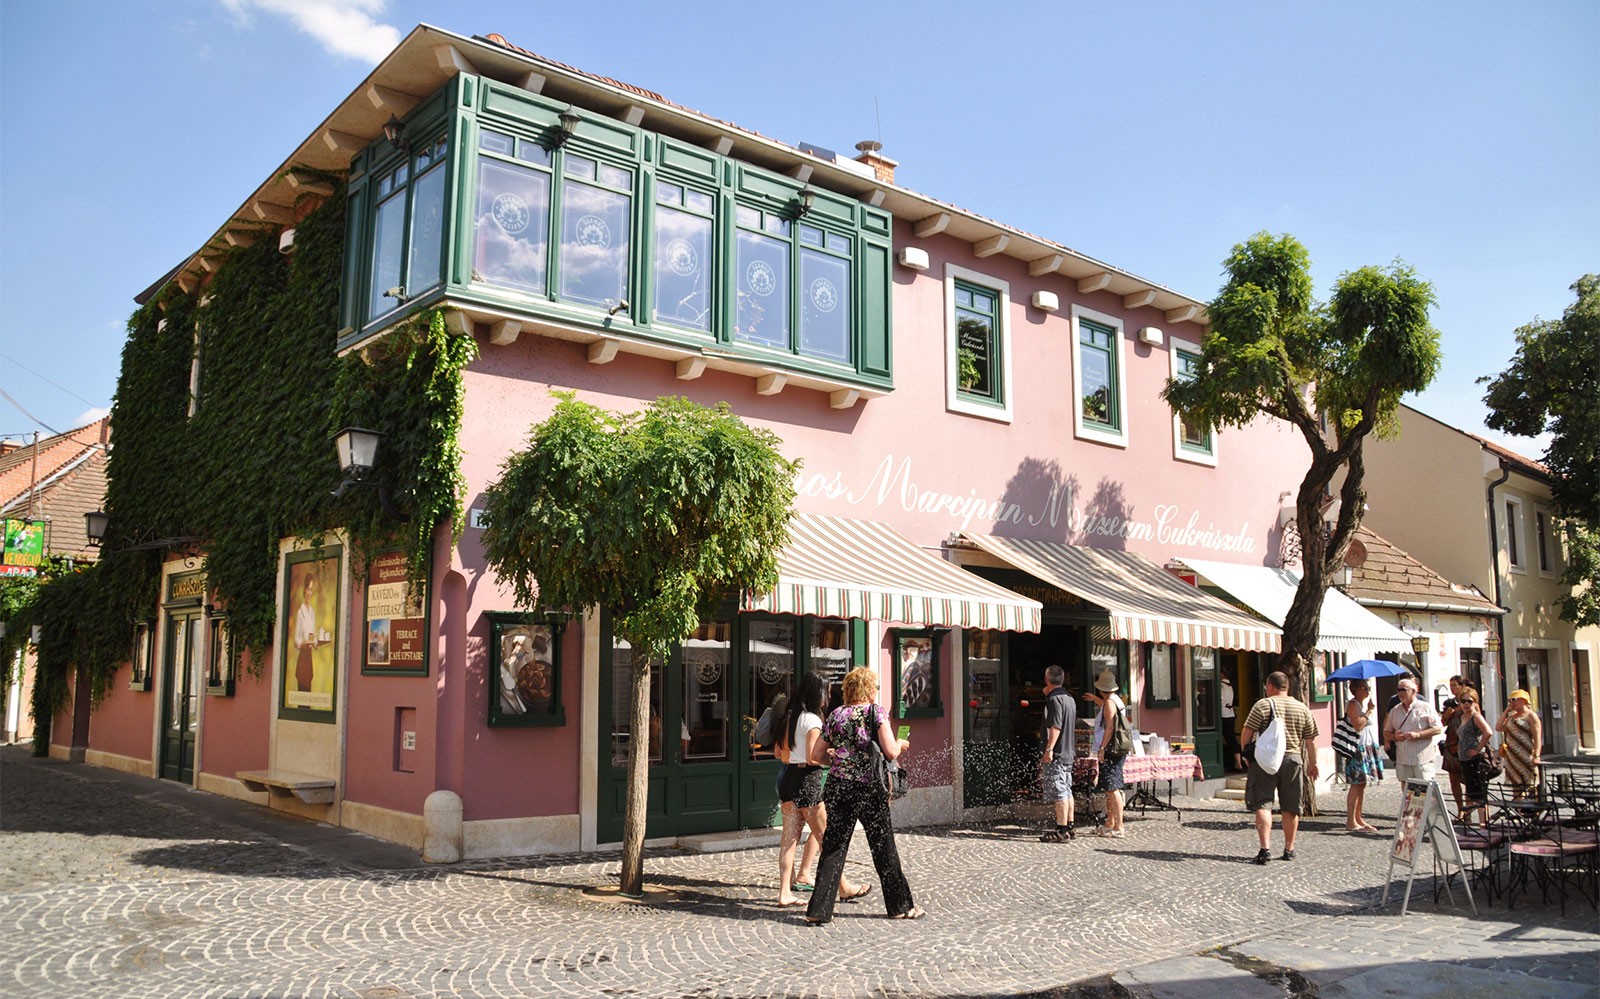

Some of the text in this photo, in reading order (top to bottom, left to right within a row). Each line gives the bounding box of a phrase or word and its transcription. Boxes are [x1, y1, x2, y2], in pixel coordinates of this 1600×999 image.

[847, 453, 1025, 531] Marcipán
[1028, 479, 1155, 542] Múzeum
[1154, 504, 1256, 554] Cukrászda
[396, 630, 418, 639] TERRACE
[402, 640, 411, 650] and
[390, 650, 424, 661] CAFÉ UPSTAIRS
